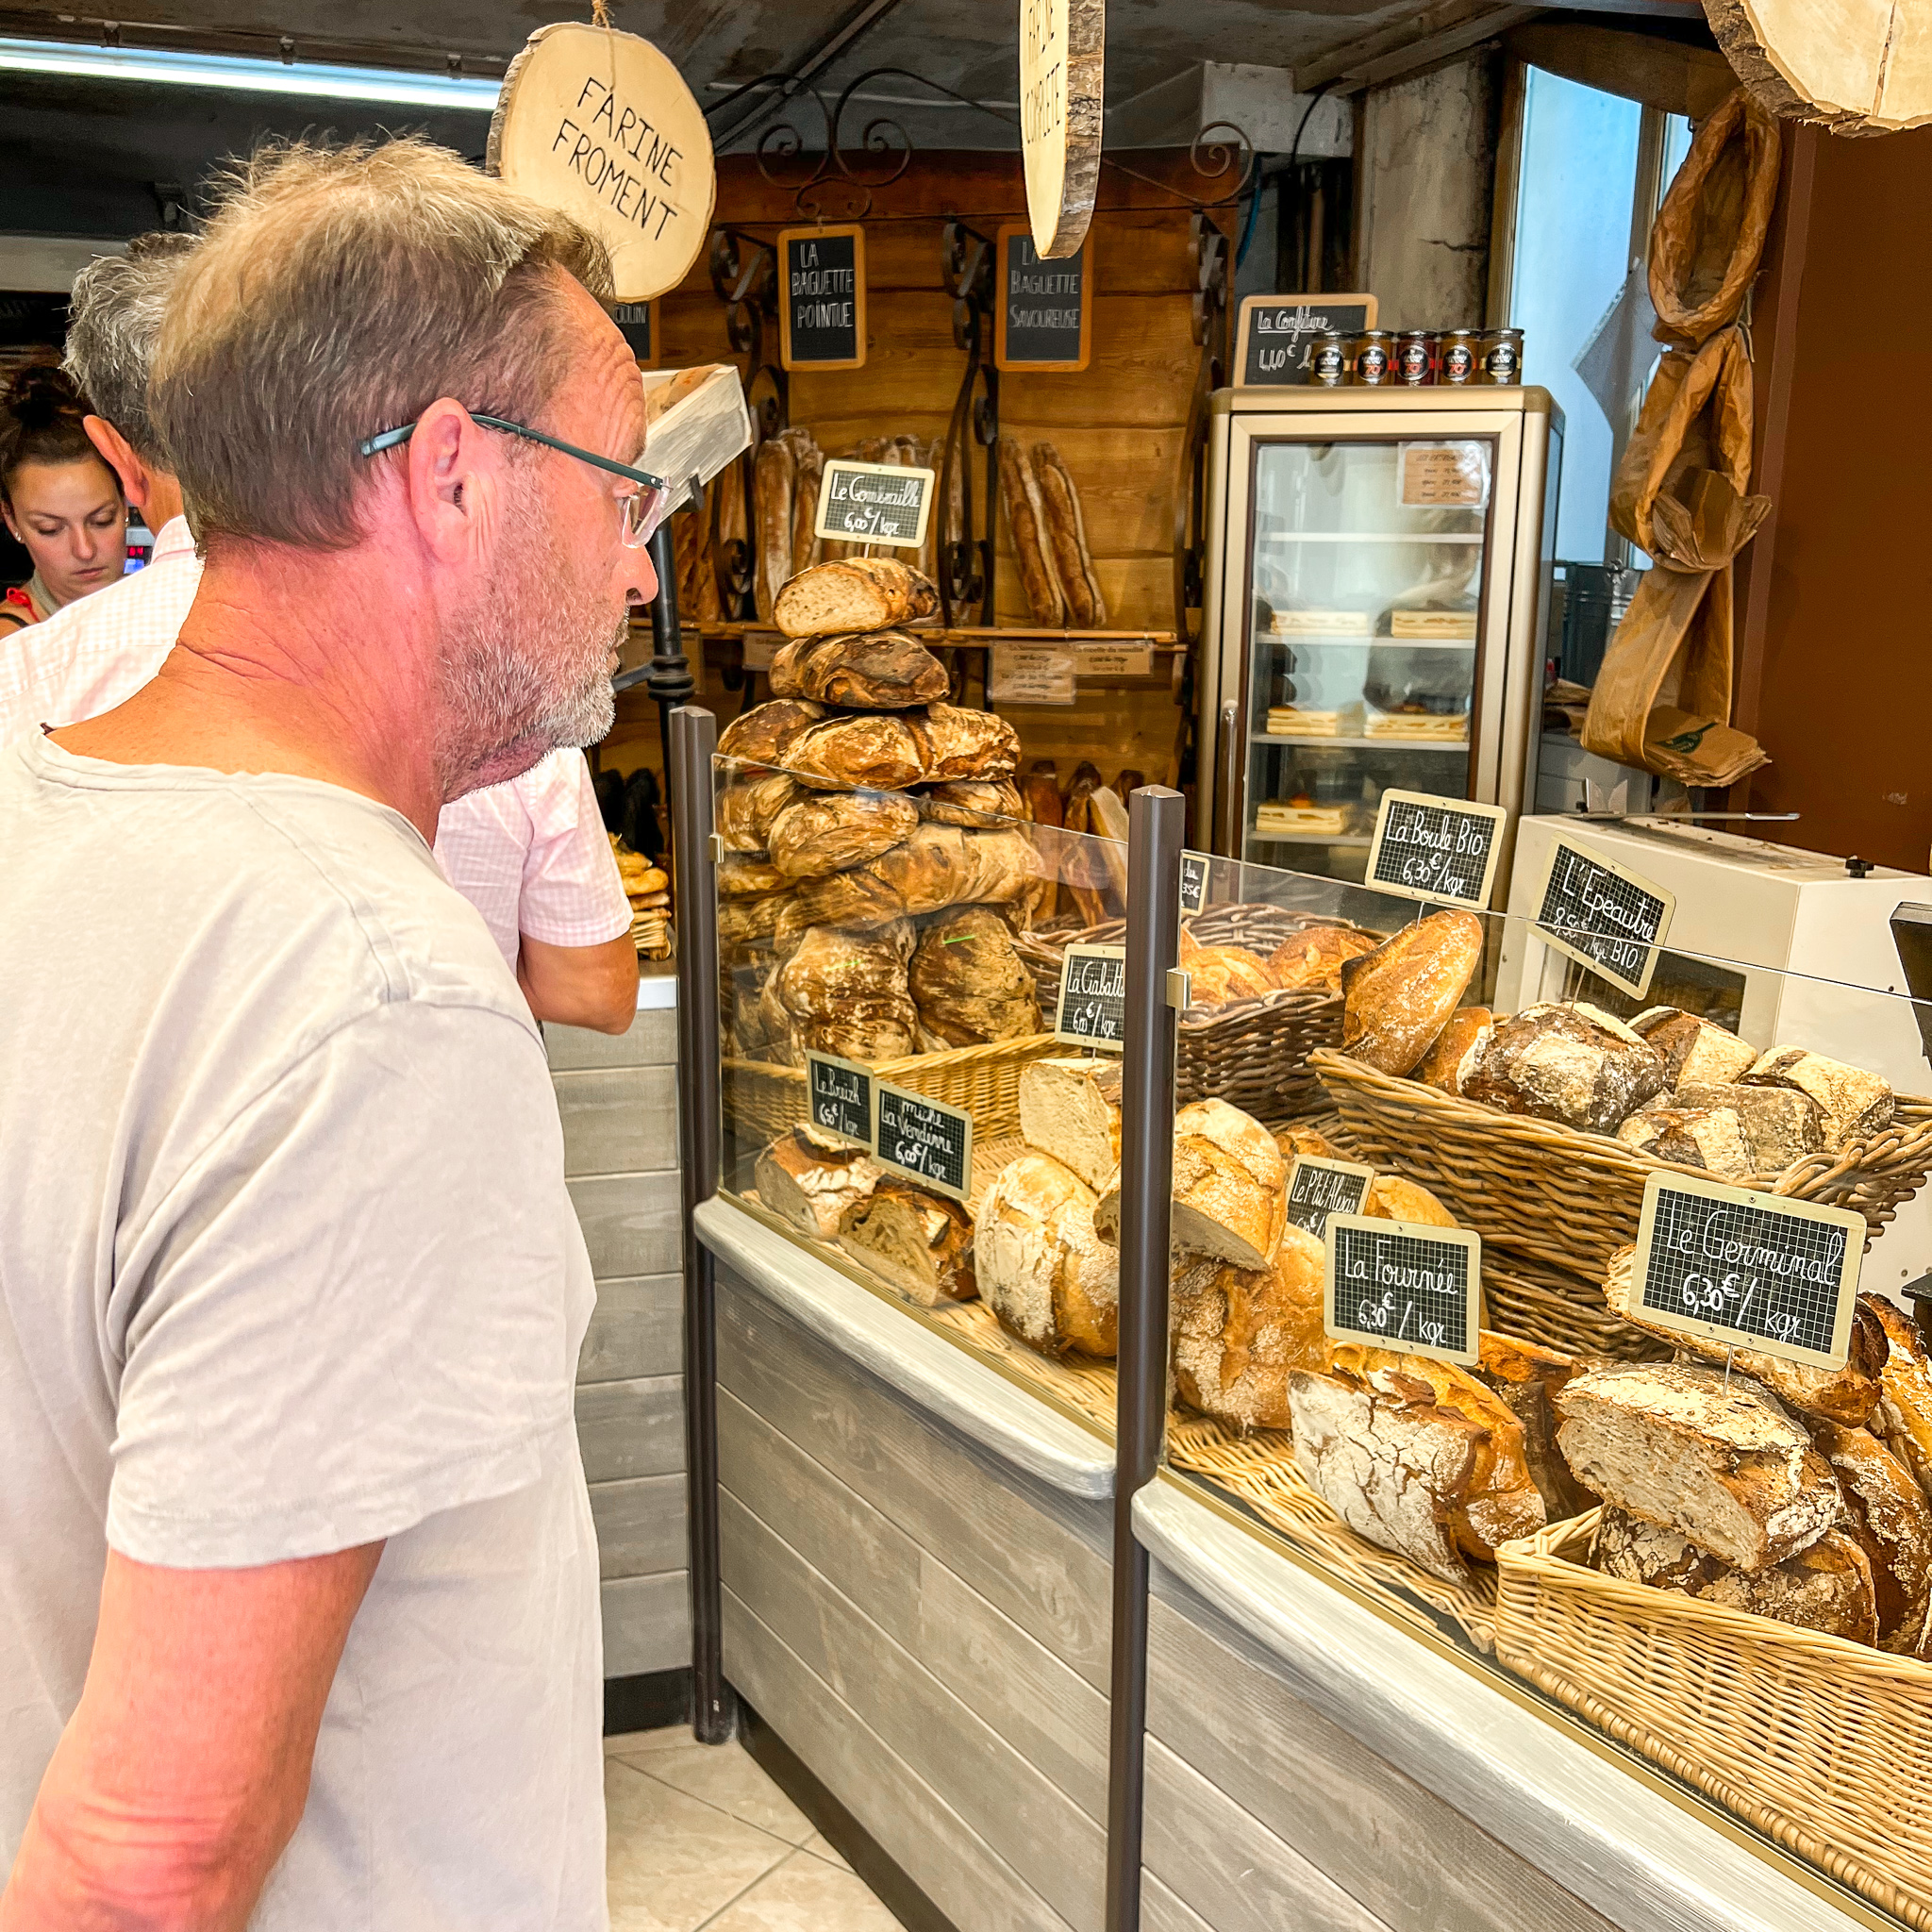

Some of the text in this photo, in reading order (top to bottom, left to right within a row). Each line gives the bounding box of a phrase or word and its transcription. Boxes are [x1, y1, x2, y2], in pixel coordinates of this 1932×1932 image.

[576, 76, 684, 187] FARINE
[553, 118, 678, 242] FROMENT
[800, 242, 819, 268] LA
[791, 269, 855, 296] BAGUETTE
[1010, 270, 1080, 294] BAGUETTE
[831, 473, 847, 500] Le
[1386, 805, 1484, 856] La Boule Bio
[1067, 957, 1080, 994] La
[814, 1062, 829, 1094] Le
[881, 1092, 897, 1126] La
[1291, 1167, 1304, 1203] Le
[1667, 1198, 1842, 1286] Le Germinal
[1345, 1234, 1458, 1294] La Fournée
